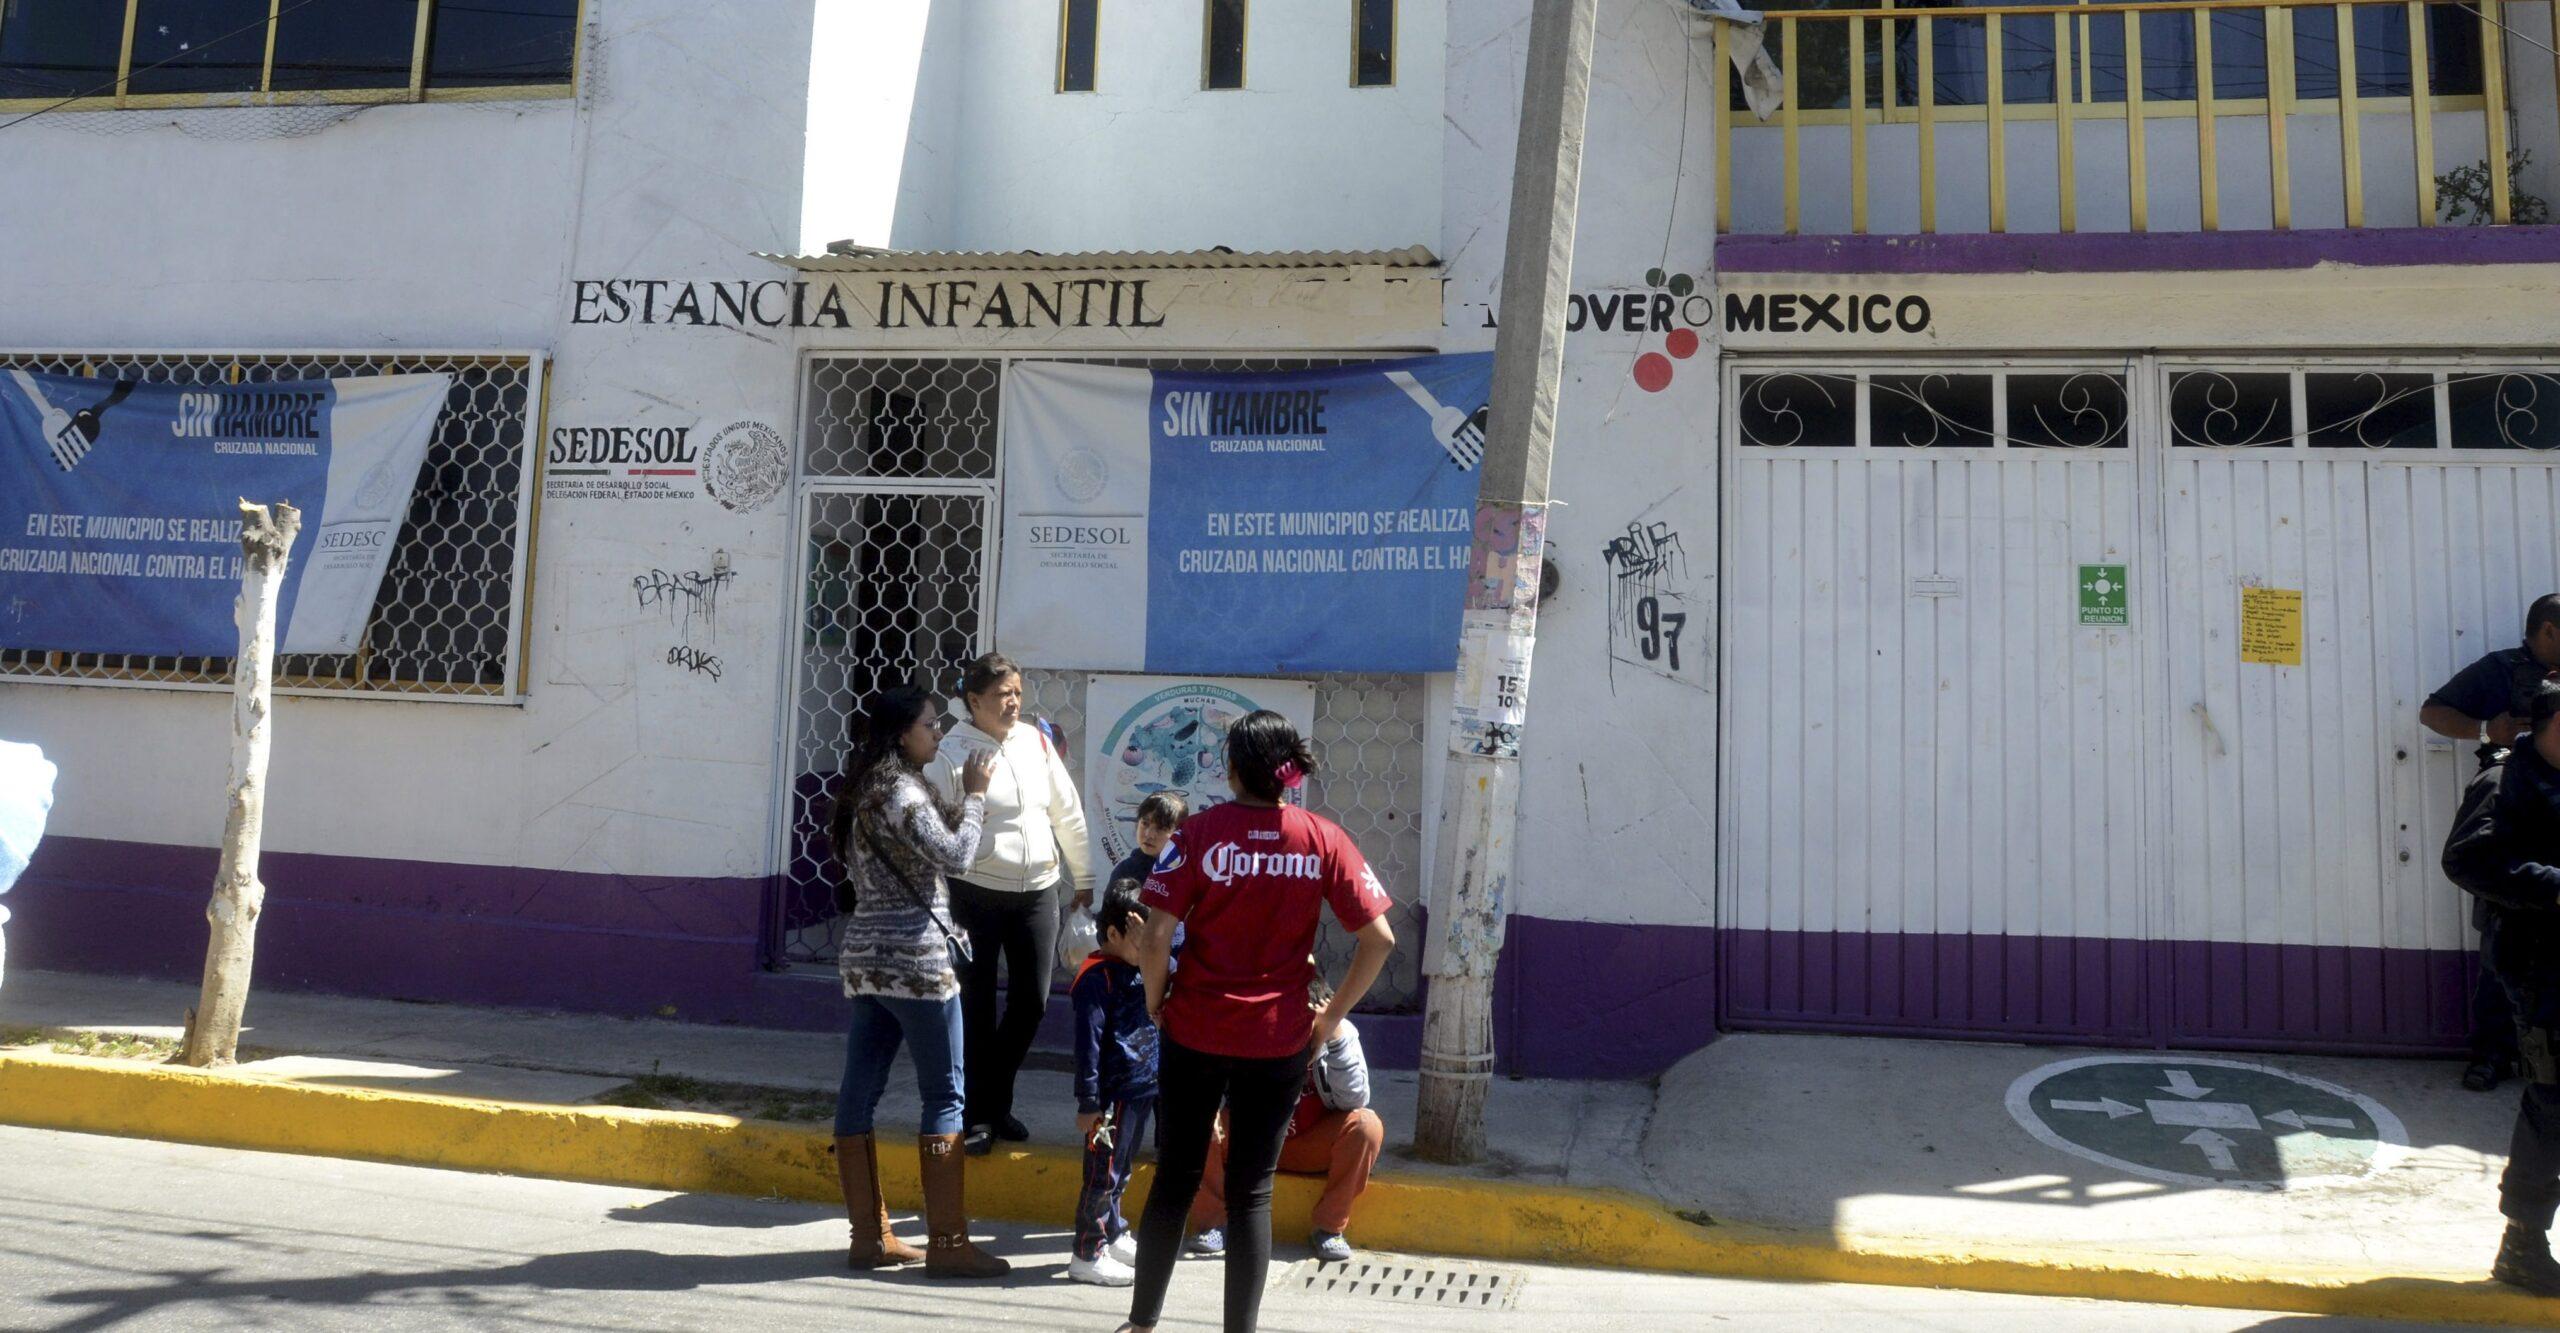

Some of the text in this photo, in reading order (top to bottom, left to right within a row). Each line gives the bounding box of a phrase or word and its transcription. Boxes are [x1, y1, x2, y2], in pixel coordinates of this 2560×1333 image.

[570, 278, 1166, 328] ESTANCIA INFANTIL
[1566, 293, 1931, 333] OVER MEXICO
[214, 442, 318, 455] CRUZADA NACIONAL
[549, 427, 698, 463] SEDESOL
[702, 421, 788, 474] ESTADOS UNIDOS MEXICANOS
[1210, 439, 1326, 453] CRUZADA NACIONAL
[546, 481, 671, 490] SECRETARIA DE DESARROLLO SOCIAL
[624, 491, 653, 500] ESTADO
[654, 491, 664, 499] DE
[666, 491, 695, 499] MEXICO
[26, 513, 243, 543] EN ESTE MUNICIPIO SE REALIZ
[1207, 508, 1470, 536] EN ESTE MUNICIPIO SE REALIZA
[1030, 526, 1130, 544] SEDESOL
[0, 548, 67, 573] CRUZADA
[70, 551, 142, 577] NACIONAL
[145, 554, 205, 579] CONTRA
[208, 556, 226, 580] EL
[1090, 561, 1118, 569] SOCIAL
[1098, 551, 1108, 559] DE
[1179, 549, 1258, 573] CRUZADA
[1262, 548, 1347, 573] NACIONAL
[1351, 546, 1419, 572] CONTRA
[1423, 546, 1445, 570] EL
[2081, 606, 2125, 615] PUNTO DE
[1637, 596, 1686, 671] 97
[1206, 686, 1237, 700] FRUTAS
[1498, 675, 1518, 692] 15
[1202, 841, 1322, 887] Corona
